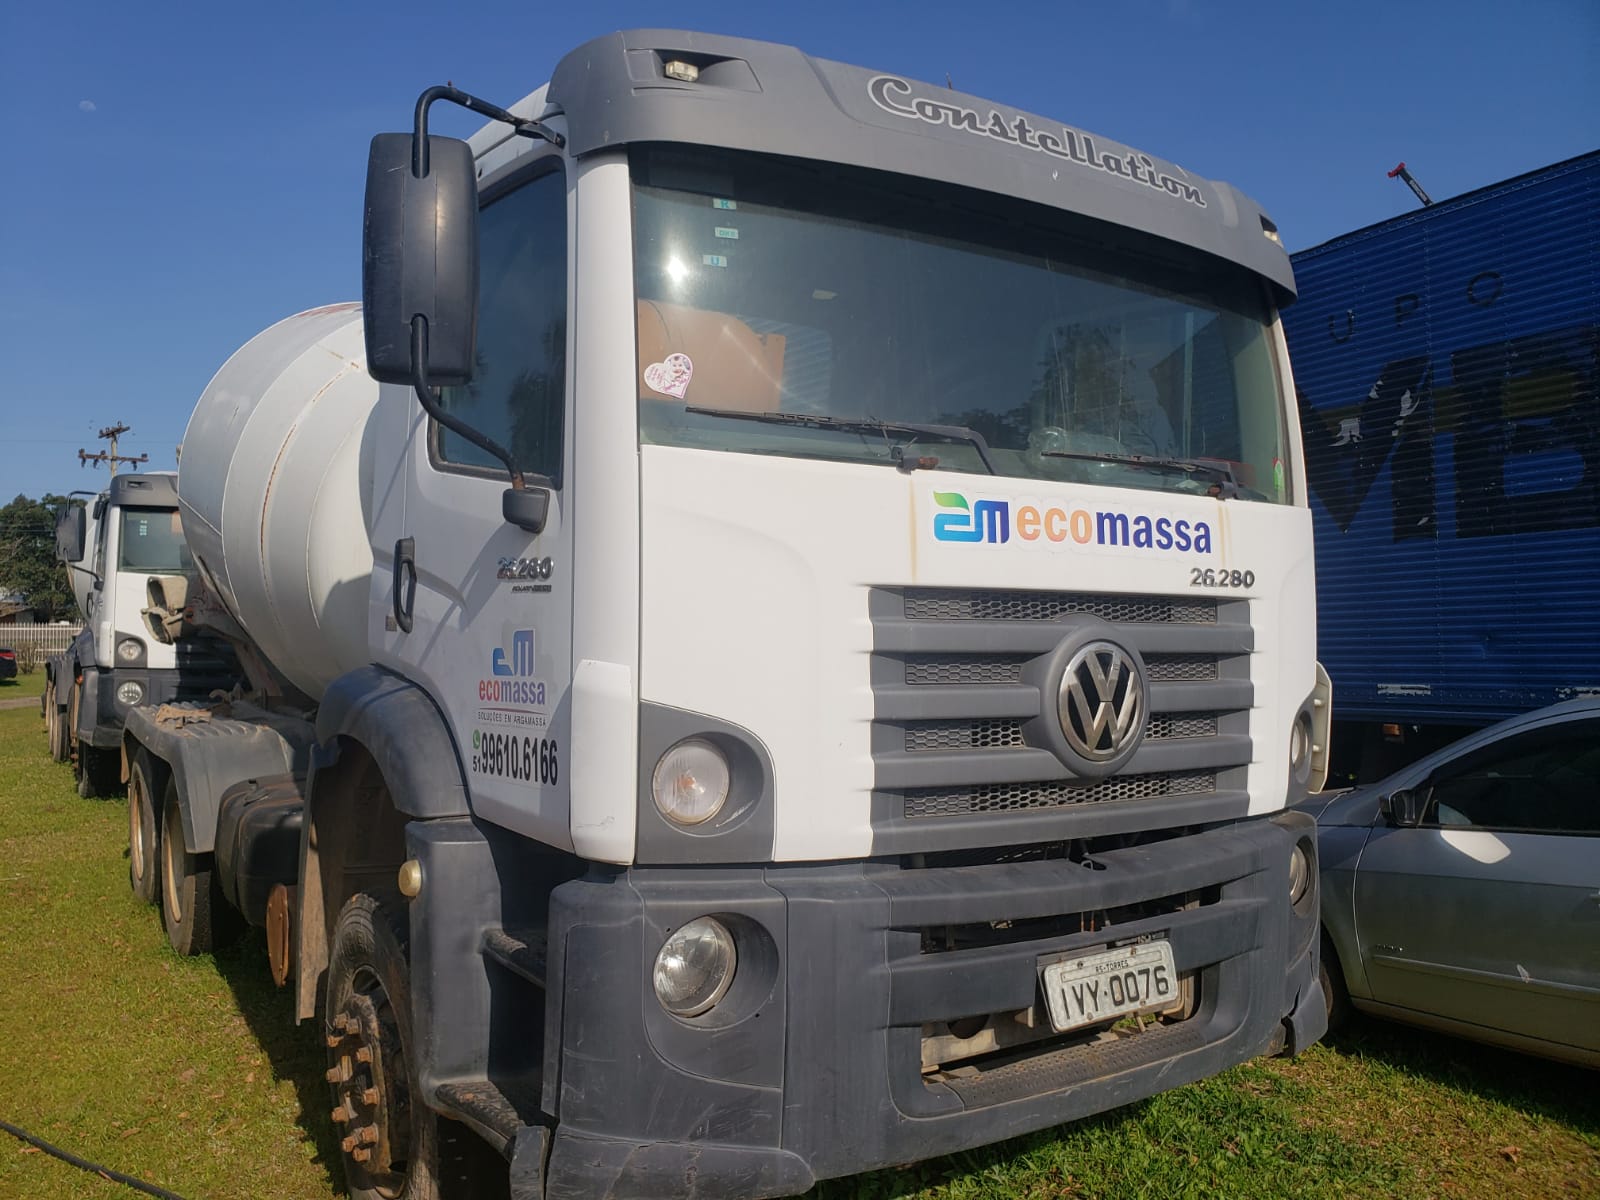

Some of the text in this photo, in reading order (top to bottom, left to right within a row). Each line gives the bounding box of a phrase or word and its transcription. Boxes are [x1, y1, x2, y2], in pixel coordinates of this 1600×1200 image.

[868, 76, 1206, 207] Constellation
[1016, 504, 1212, 554] ecomassa
[1189, 566, 1256, 589] 26.280
[479, 678, 546, 705] ecomassa
[504, 713, 512, 723] EM
[513, 715, 546, 727] ARGAMASSA
[472, 731, 558, 786] 51 99610.6166
